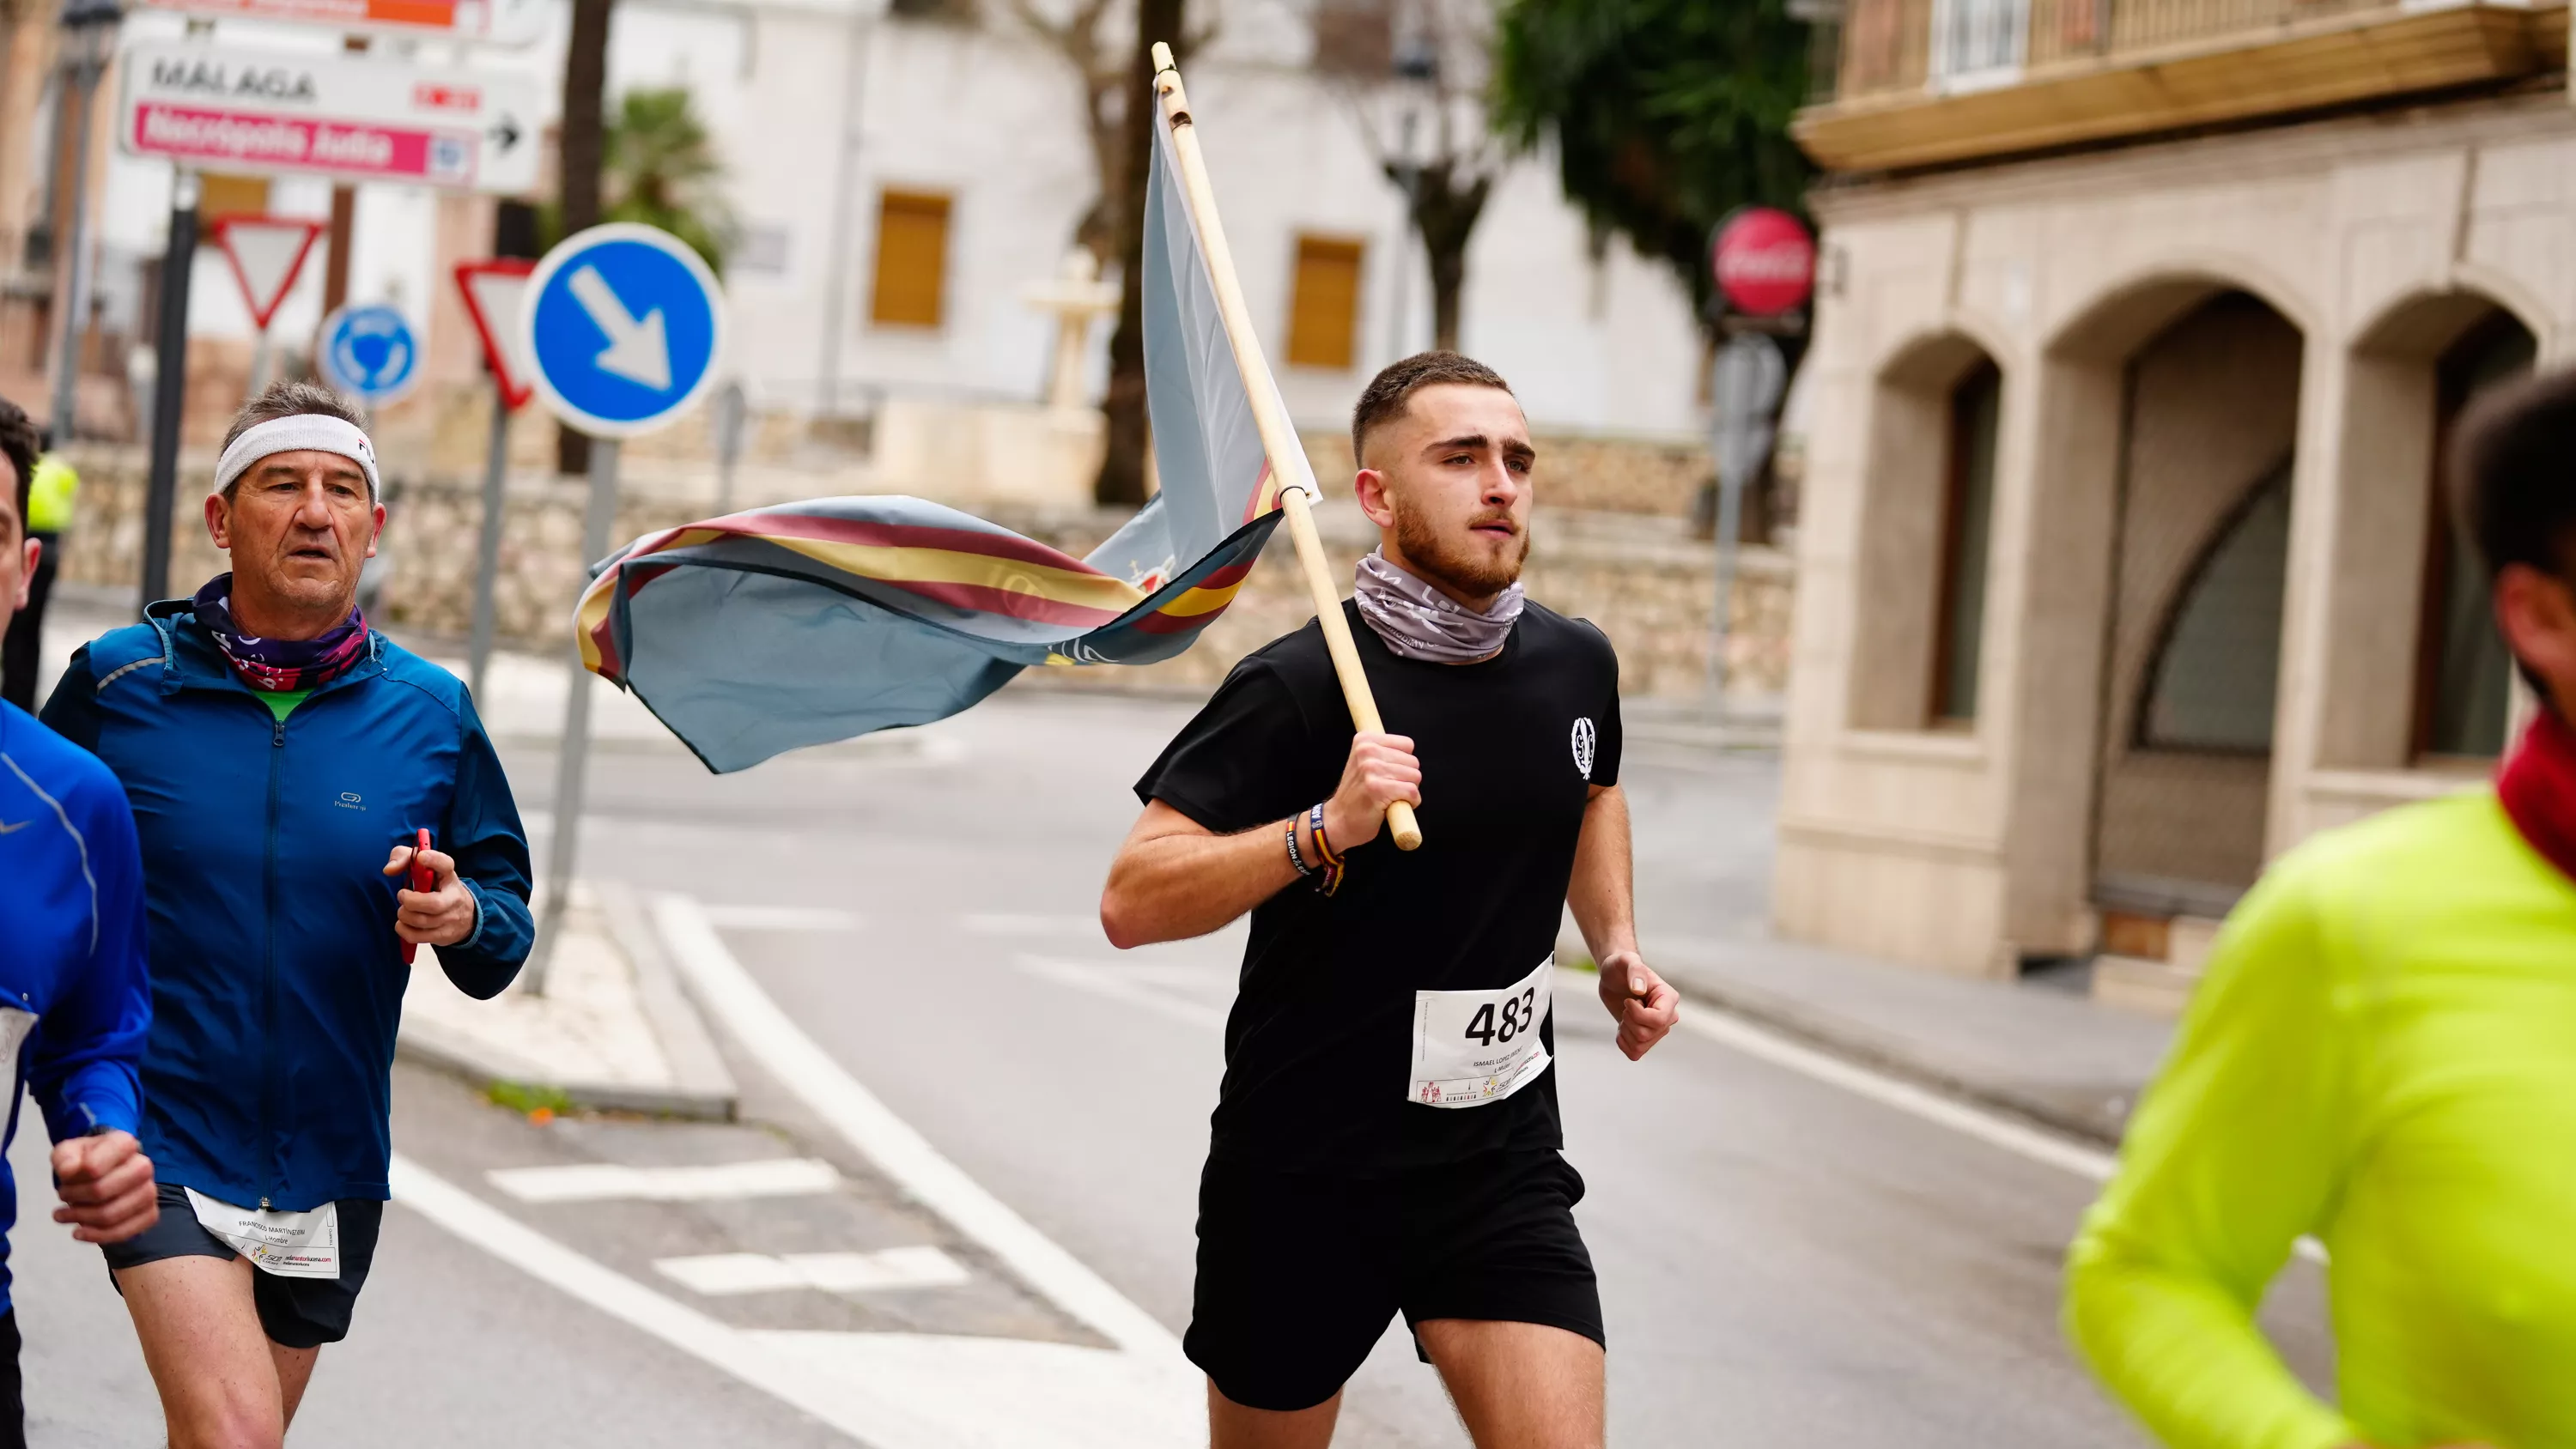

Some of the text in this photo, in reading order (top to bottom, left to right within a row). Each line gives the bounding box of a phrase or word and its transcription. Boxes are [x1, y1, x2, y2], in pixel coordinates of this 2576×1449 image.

[151, 58, 317, 103] MÁLAGA
[1287, 832, 1297, 859] LEGIÓN
[1465, 987, 1534, 1046] 483
[239, 1221, 268, 1232] FRANCISCO
